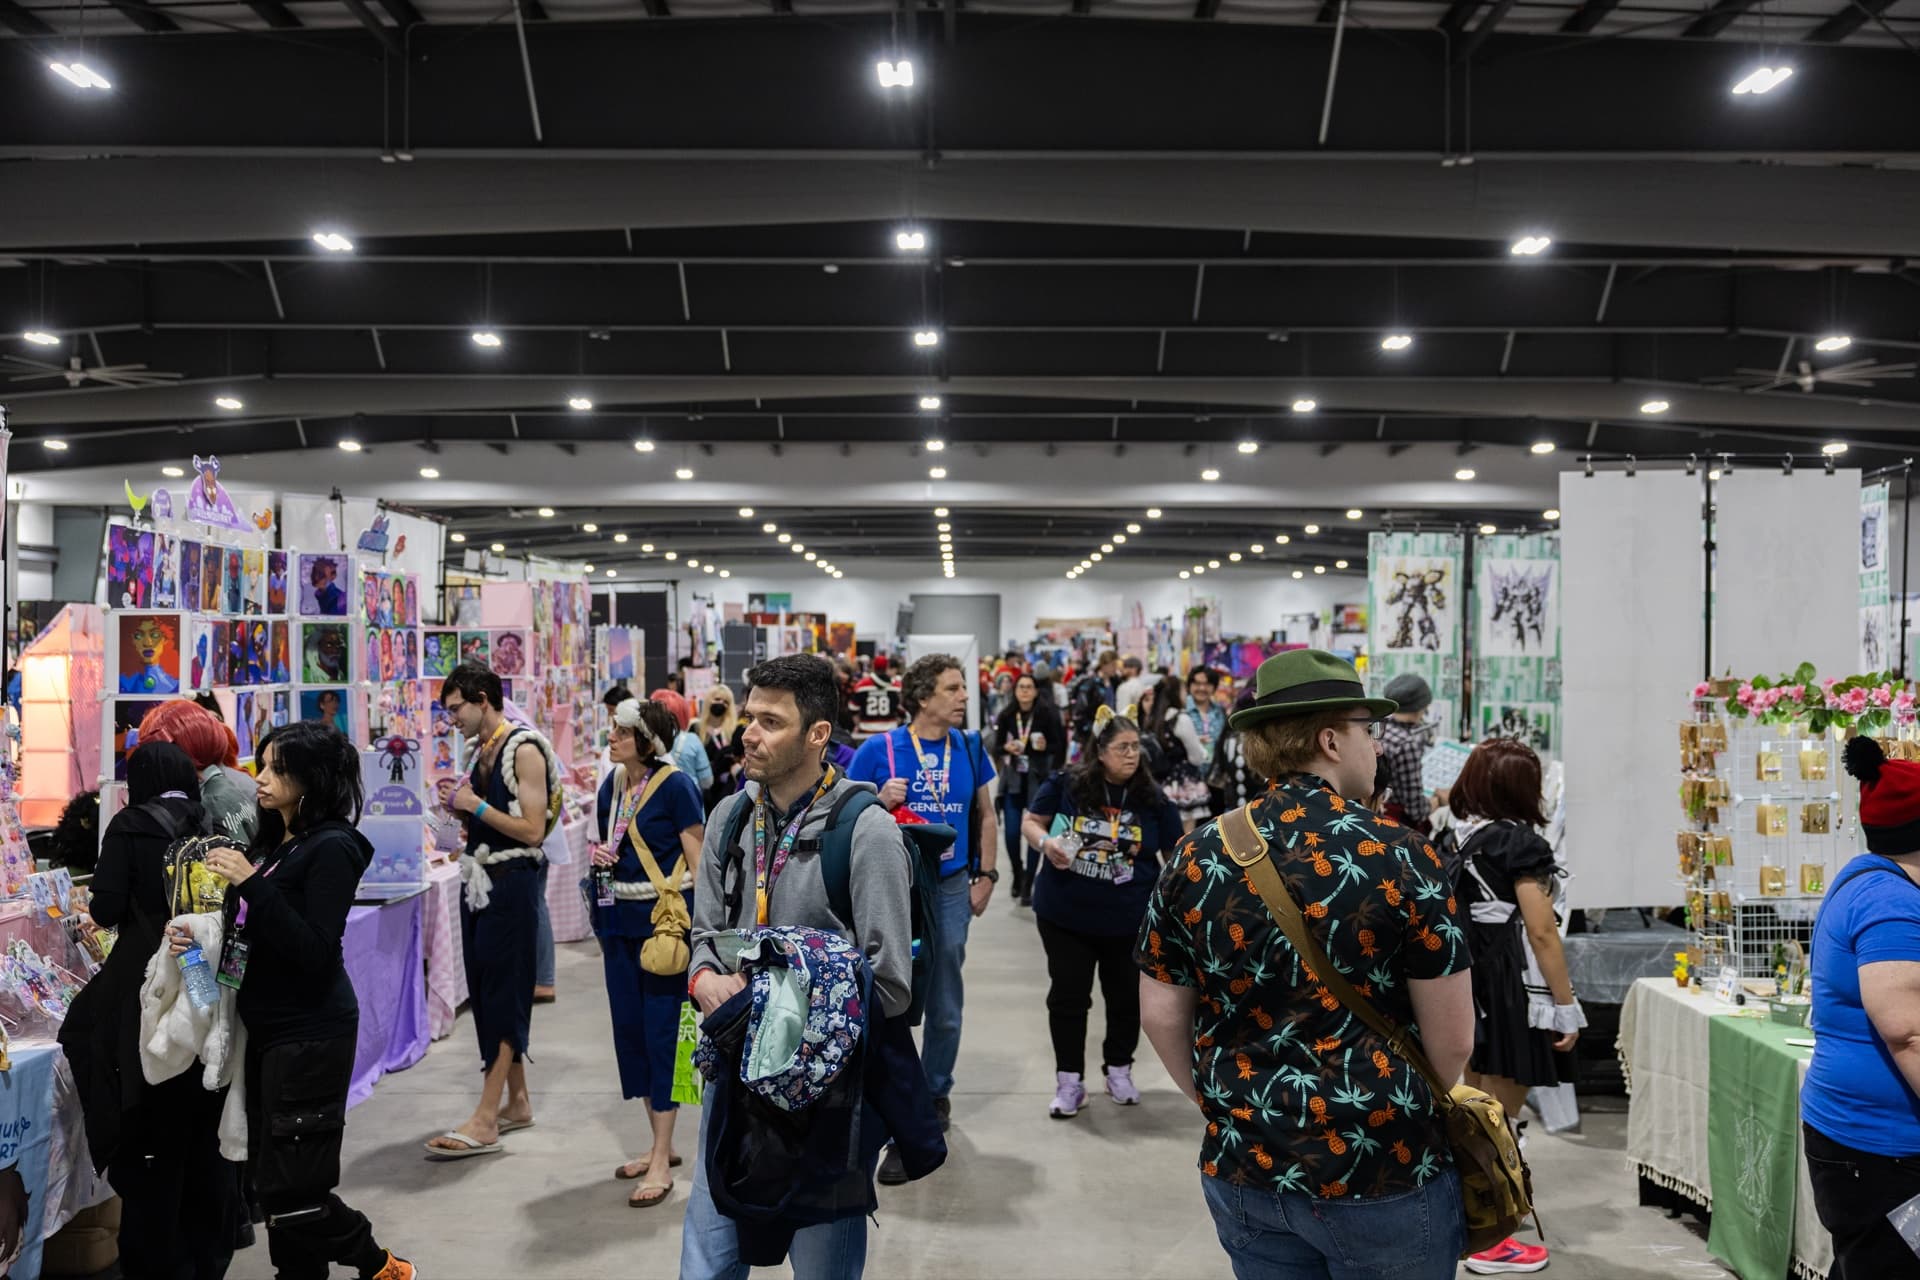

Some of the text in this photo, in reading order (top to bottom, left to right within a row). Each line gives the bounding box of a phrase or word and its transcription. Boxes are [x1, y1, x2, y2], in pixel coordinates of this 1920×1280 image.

[866, 696, 890, 716] 28
[916, 769, 946, 781] KEP
[911, 781, 950, 793] CALM
